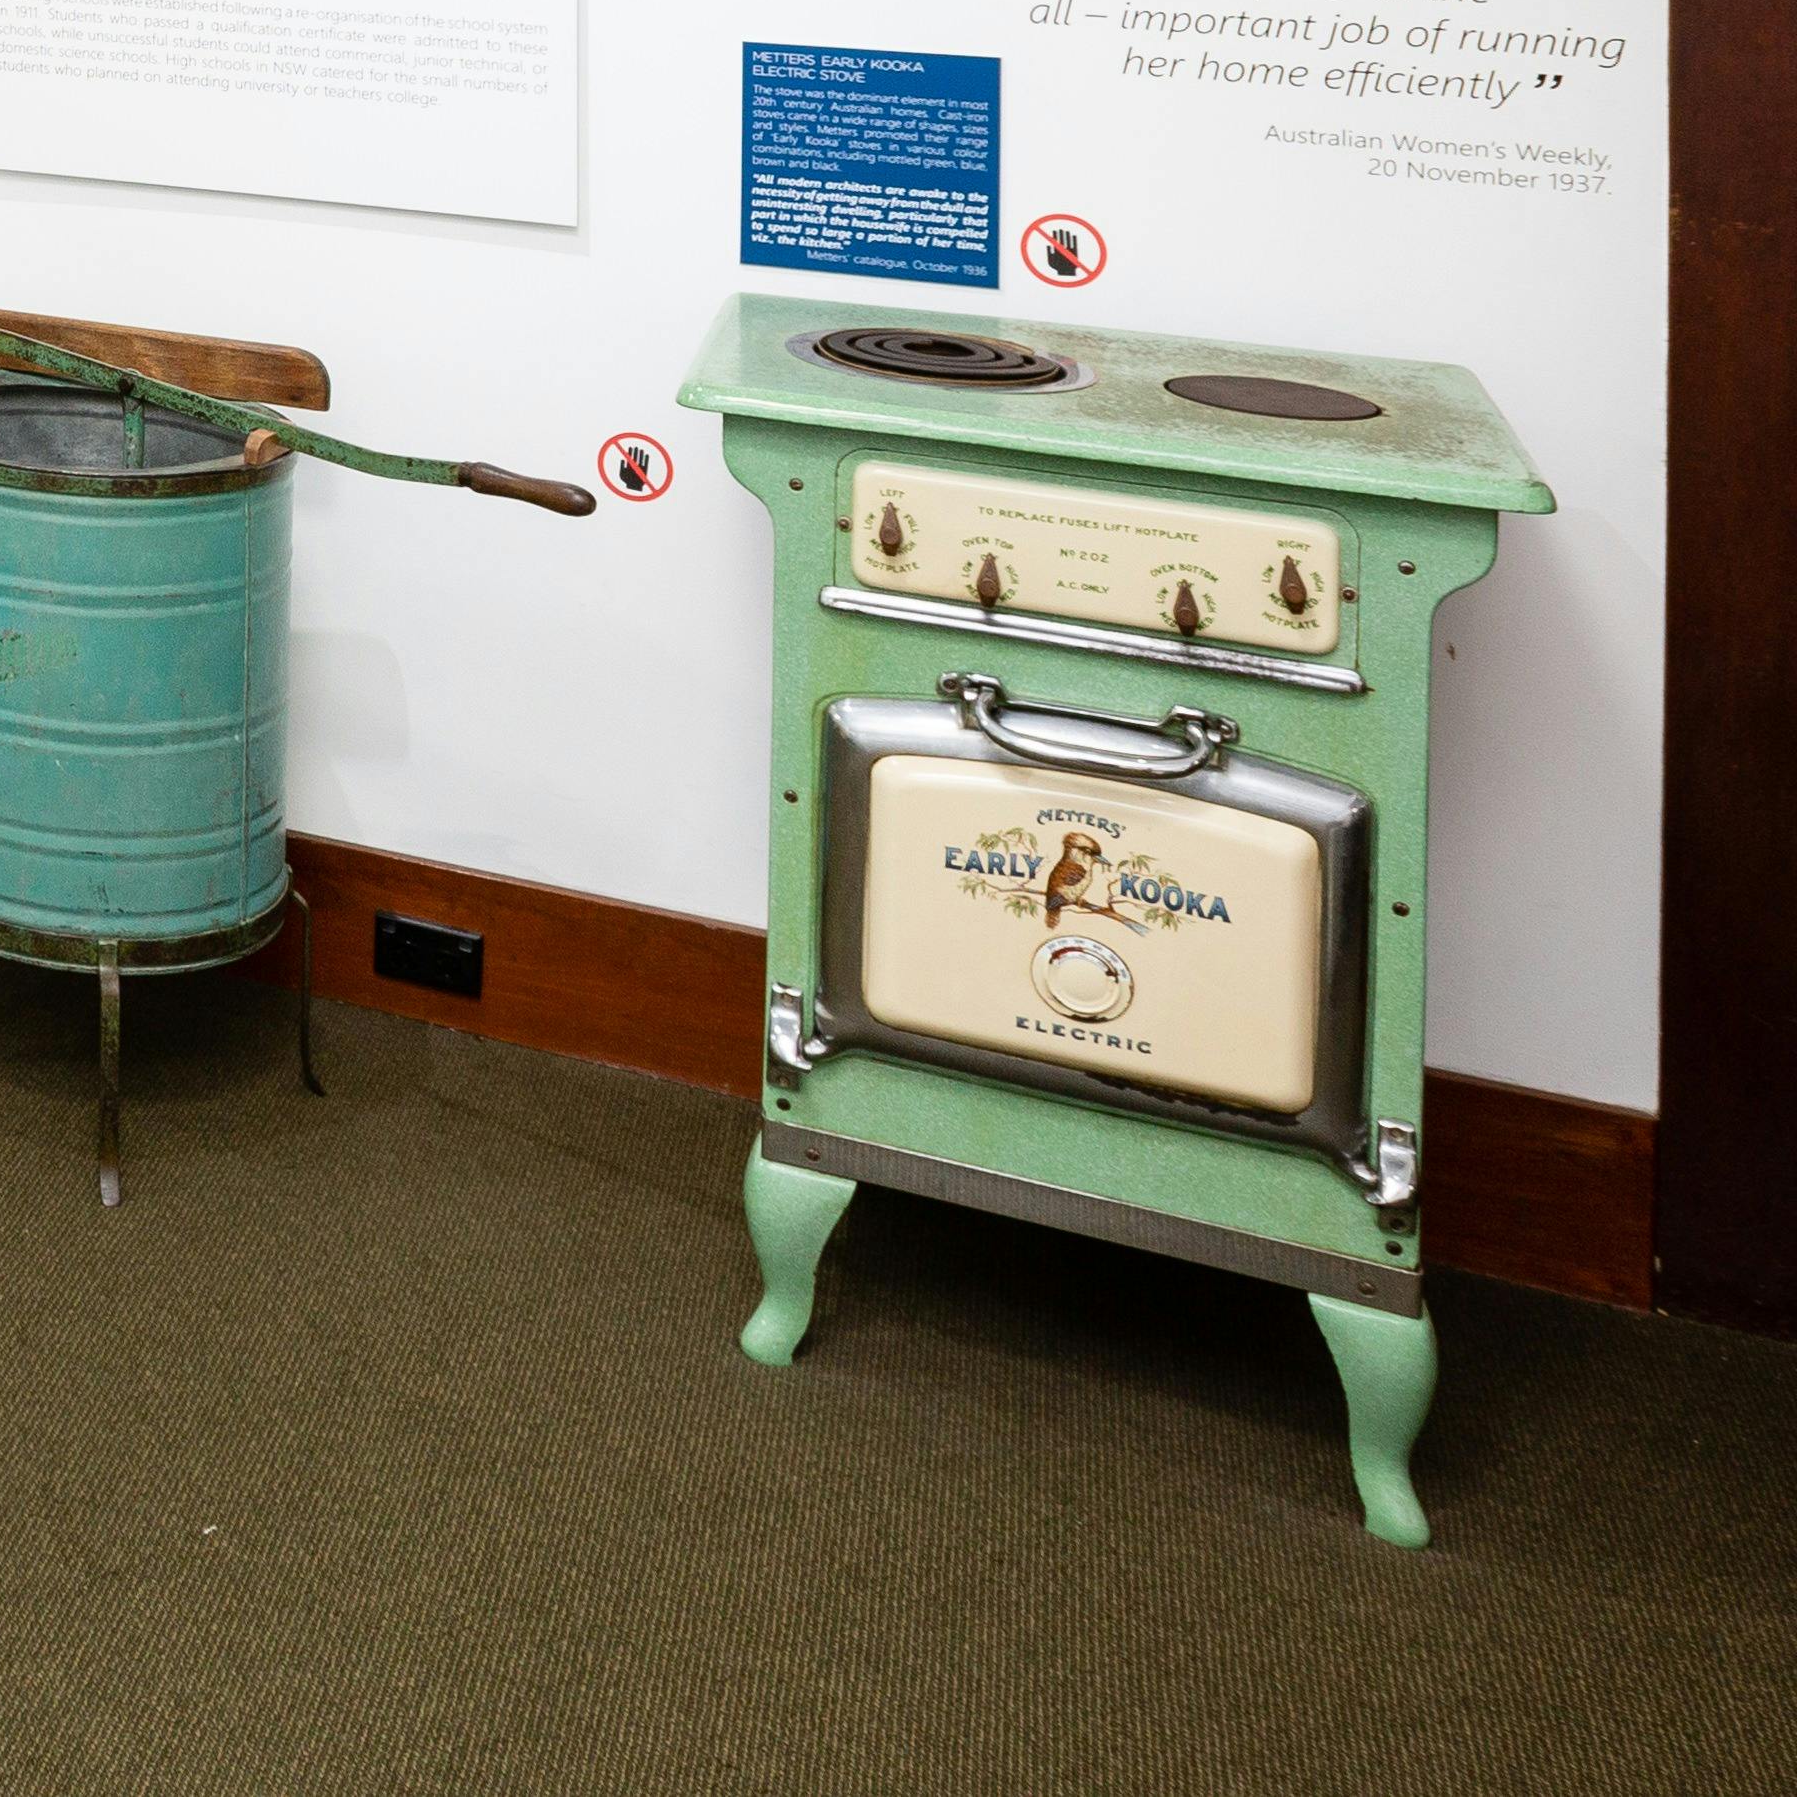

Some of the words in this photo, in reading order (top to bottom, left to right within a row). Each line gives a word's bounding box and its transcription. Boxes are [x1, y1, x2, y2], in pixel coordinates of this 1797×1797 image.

[1121, 1, 1315, 41] important
[1319, 16, 1390, 52] job
[1406, 19, 1450, 55] of
[1458, 28, 1628, 70] running
[753, 50, 816, 66] METTERS
[821, 56, 867, 69] EARLY
[870, 60, 925, 73] KOOKA
[1123, 47, 1185, 77] her
[1198, 52, 1308, 87] home
[753, 66, 816, 80] ELECTRIC
[820, 70, 866, 84] STOVE
[1265, 125, 1382, 149] Australian
[1392, 134, 1506, 159] Women's
[1516, 144, 1611, 171] Weekly,
[1368, 158, 1397, 177] 20
[1408, 162, 1539, 188] November
[1549, 173, 1611, 195] 1937.
[880, 488, 905, 499] LEFT
[978, 506, 994, 516] TO
[999, 508, 1054, 524] REPLACE
[1060, 517, 1100, 530] FUSES
[1103, 522, 1130, 534] LIFT
[1135, 527, 1200, 544] HOTPLATE
[962, 536, 990, 548] OVEN
[993, 536, 1015, 551] TOP
[1276, 538, 1312, 552] RIGHT
[864, 556, 921, 573] HOTPLATE
[1079, 550, 1110, 564] 202
[1149, 562, 1176, 578] OVEN
[1178, 562, 1220, 584] BOTTOM
[1261, 610, 1321, 631] HOTPLATE
[945, 845, 1045, 880] EARLY
[1120, 872, 1232, 924] KOOKA
[1016, 1016, 1153, 1056] ELECTRIC
